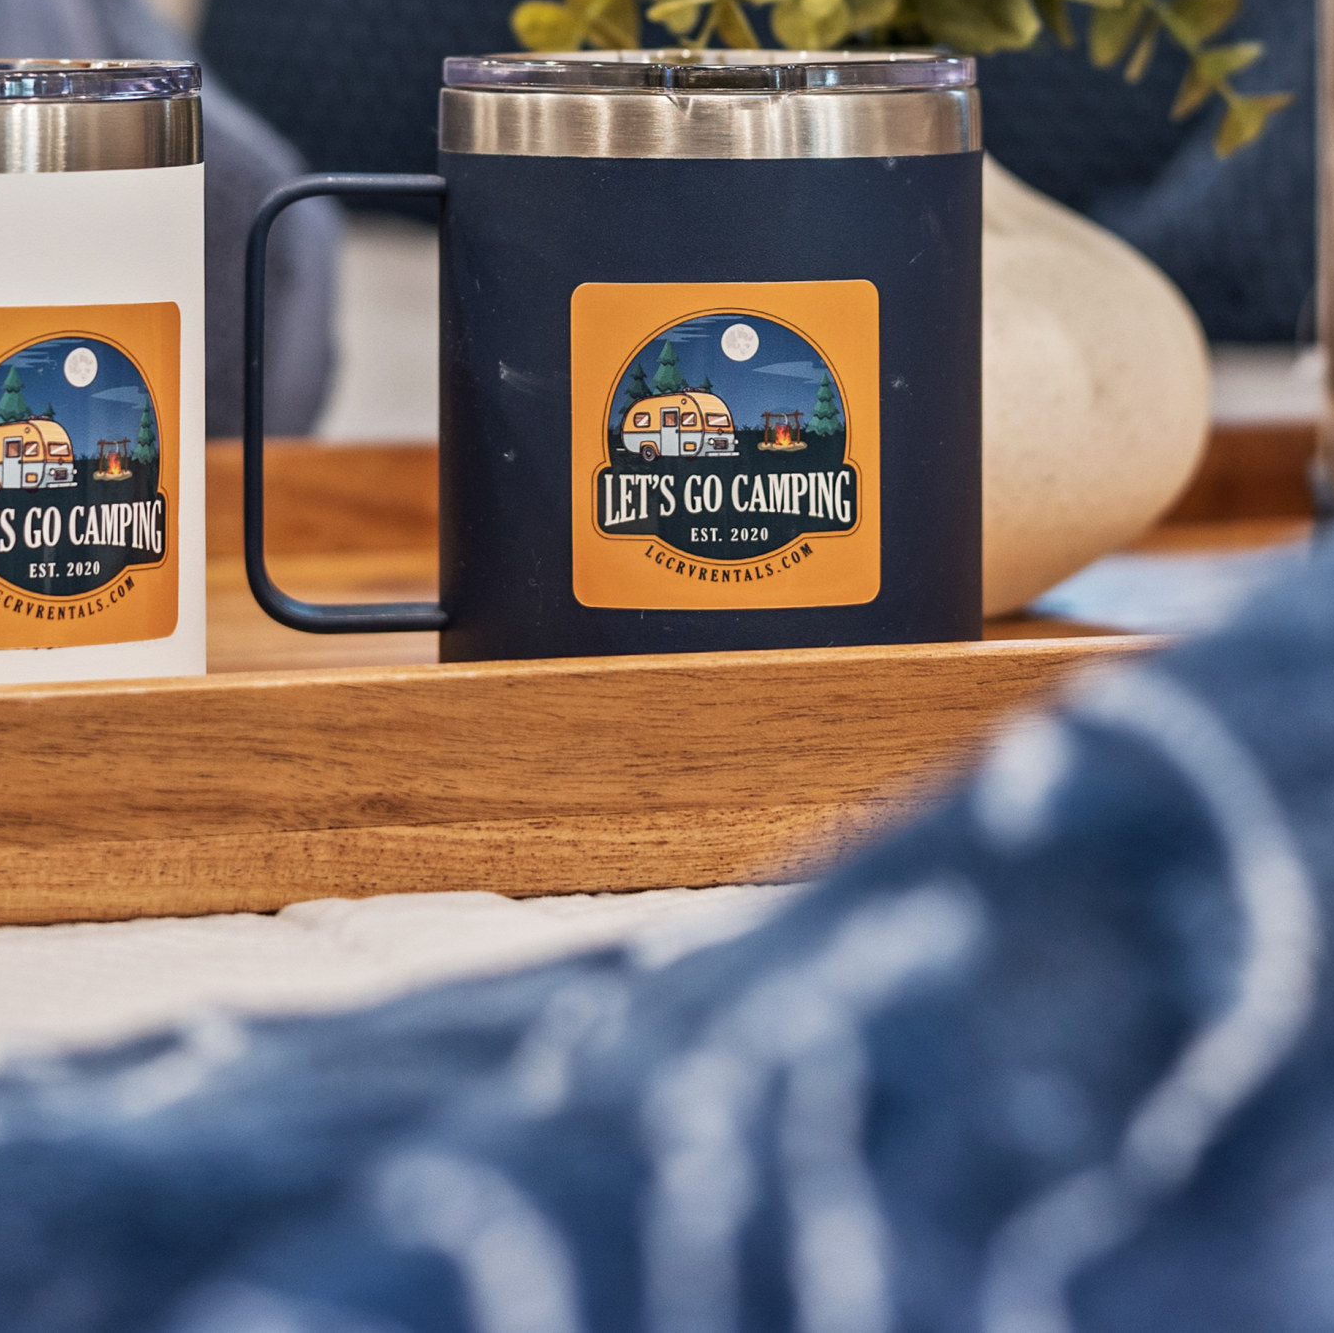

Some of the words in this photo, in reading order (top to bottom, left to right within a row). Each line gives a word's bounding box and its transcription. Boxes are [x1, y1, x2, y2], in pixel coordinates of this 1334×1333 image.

[604, 473, 676, 526] LET'S
[683, 474, 723, 514] GO
[731, 470, 851, 523] CAMPING
[23, 506, 62, 549] GO
[68, 499, 162, 554] CAMPING
[690, 527, 723, 542] EST.
[730, 527, 769, 542] 2020
[29, 563, 60, 578] EST.
[66, 560, 101, 577] 2020
[644, 542, 814, 583] LGCRVRENTALS.COM
